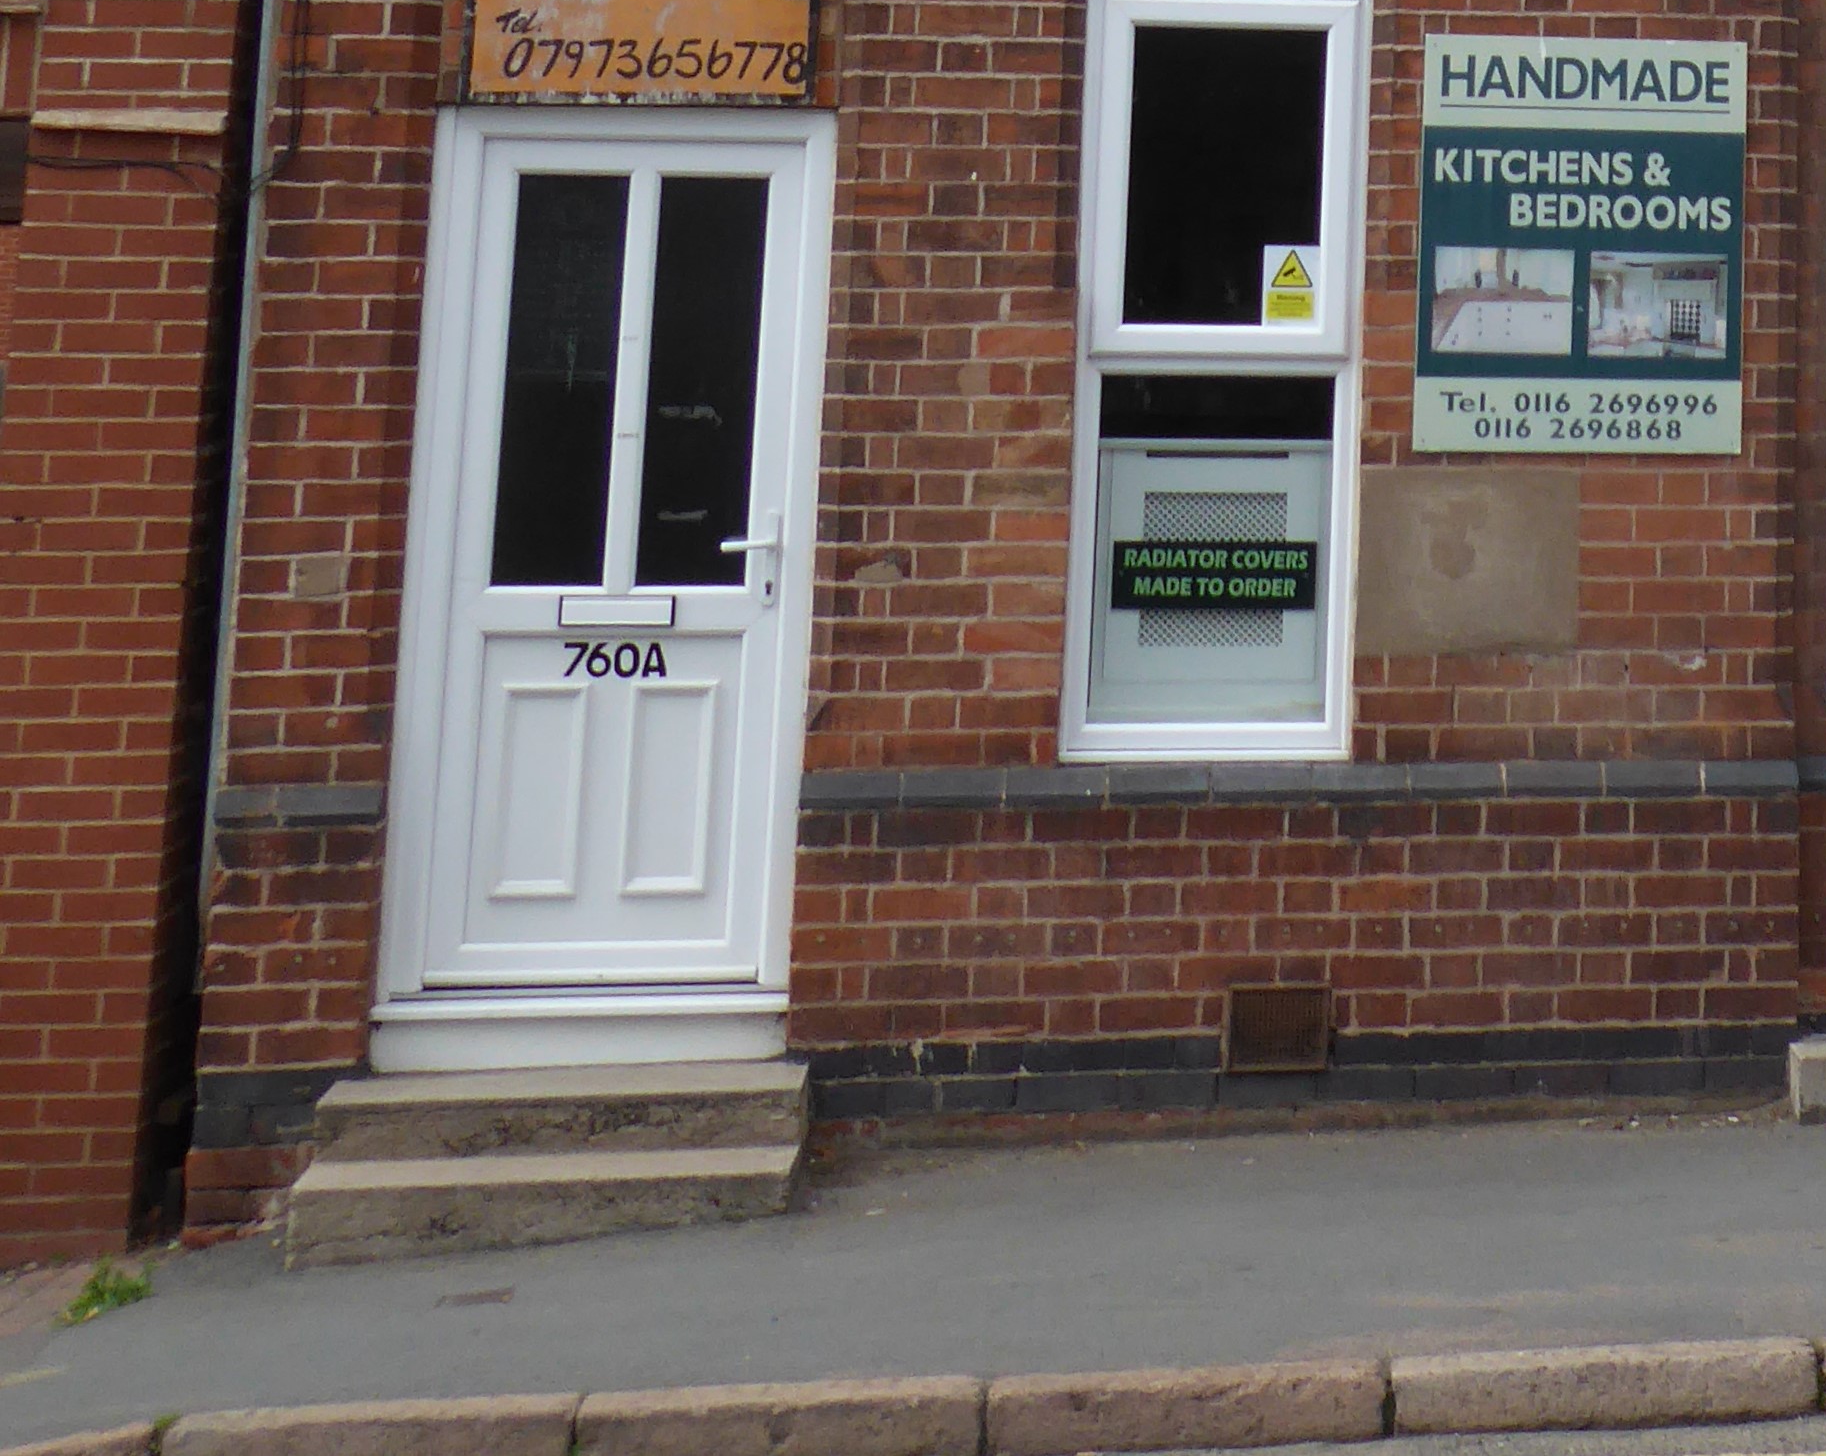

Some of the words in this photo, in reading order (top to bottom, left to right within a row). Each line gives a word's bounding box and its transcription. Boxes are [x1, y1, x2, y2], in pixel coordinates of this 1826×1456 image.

[503, 38, 807, 85] 07973656778
[1440, 54, 1731, 104] HANDMADE
[1434, 148, 1633, 187] KITCHENS
[1643, 152, 1672, 188] &
[1508, 193, 1732, 232] BEDROOMS
[1440, 391, 1496, 413] Tel.
[1514, 392, 1571, 414] 0116
[1589, 393, 1718, 415] 2696996
[1474, 418, 1532, 440] 0116
[1550, 418, 1682, 440] 2696868
[1123, 547, 1227, 569] RADIATOR
[1231, 549, 1309, 570] COVERS
[1132, 576, 1192, 596] MADE
[1195, 577, 1224, 597] TO
[1228, 577, 1297, 598] ORDER
[563, 642, 667, 678] 760A
